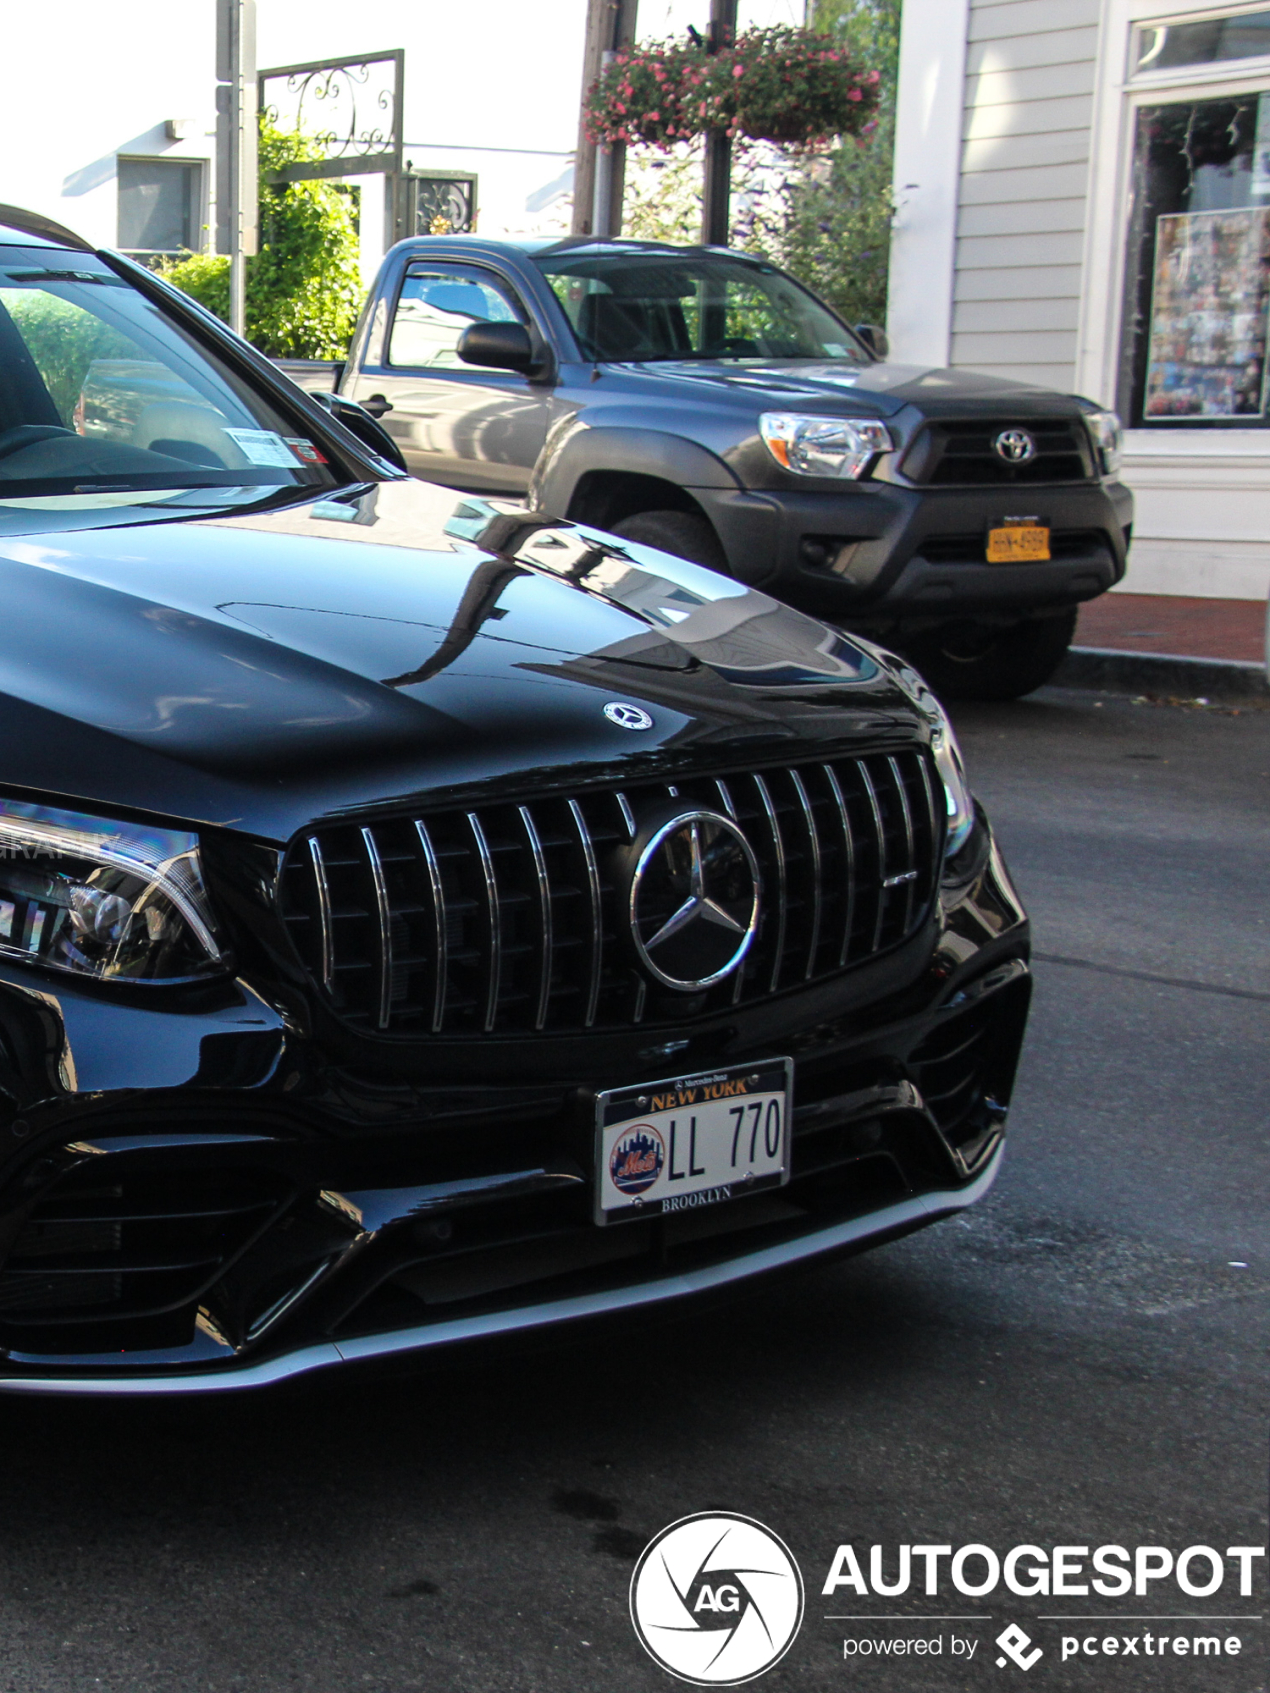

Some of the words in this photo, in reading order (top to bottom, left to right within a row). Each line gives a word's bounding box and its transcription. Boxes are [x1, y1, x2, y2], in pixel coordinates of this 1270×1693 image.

[650, 1089, 697, 1113] NEW
[703, 1077, 748, 1101] YORK
[668, 1116, 705, 1181] LL
[729, 1098, 780, 1168] 770
[618, 1150, 657, 1177] Mets
[662, 1184, 731, 1212] BROOKLYN
